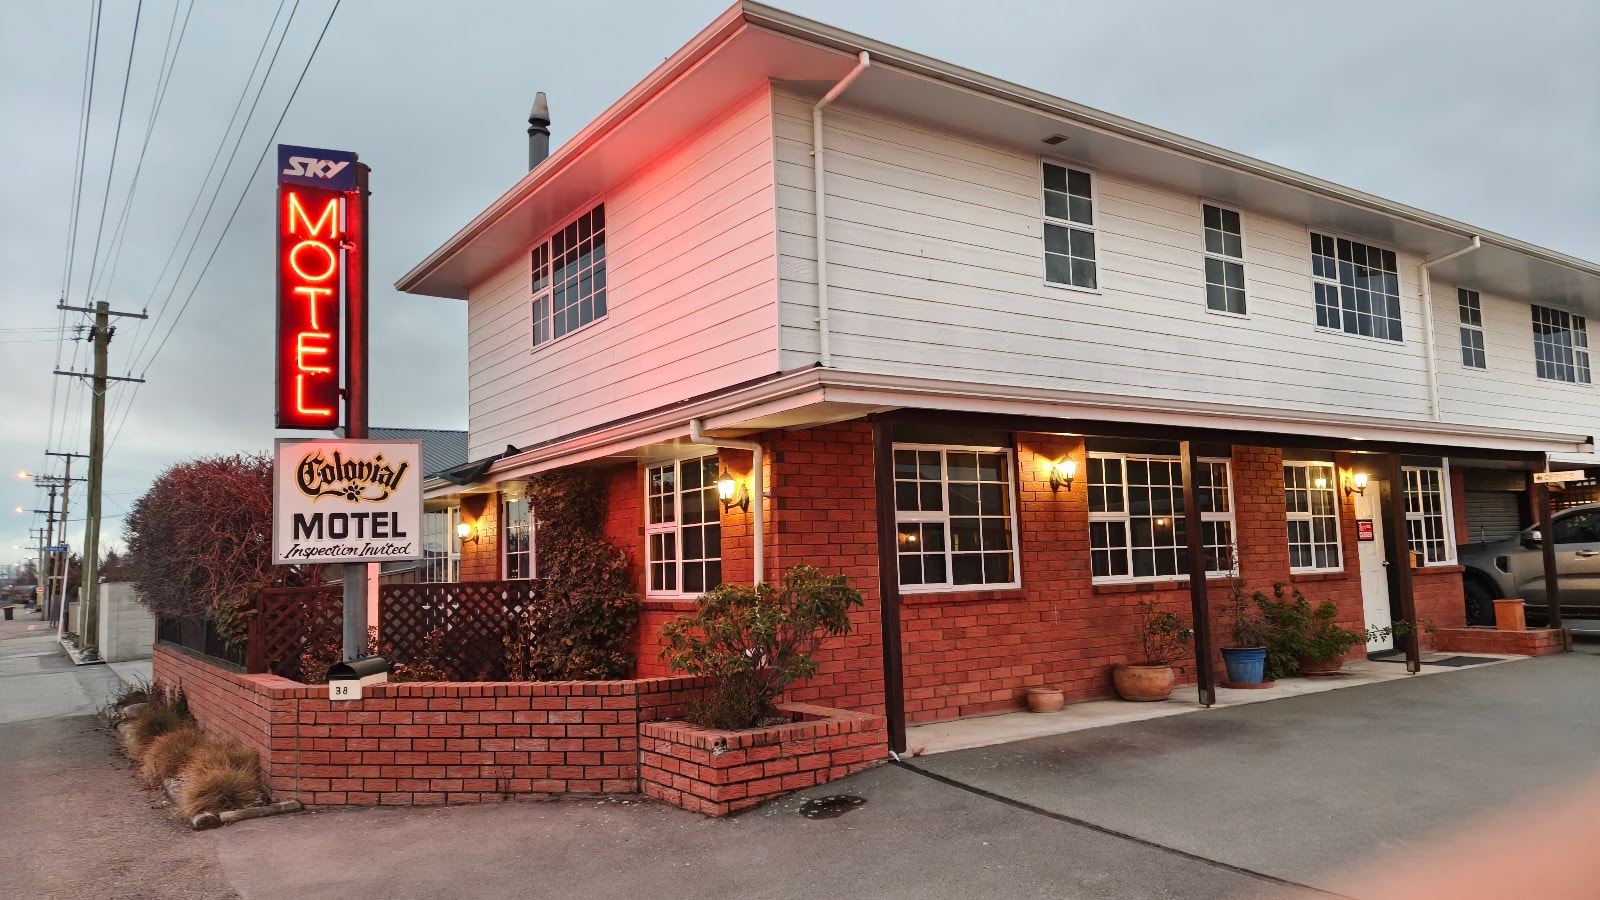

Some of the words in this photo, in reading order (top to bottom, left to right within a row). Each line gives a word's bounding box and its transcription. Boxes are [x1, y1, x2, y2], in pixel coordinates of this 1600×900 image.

[283, 156, 349, 179] SKY
[289, 192, 337, 416] MOTEL
[296, 449, 409, 496] Colonial
[293, 512, 407, 540] MOTEL
[284, 543, 358, 559] Inspection
[358, 542, 411, 557] Invited
[335, 686, 348, 695] 38
